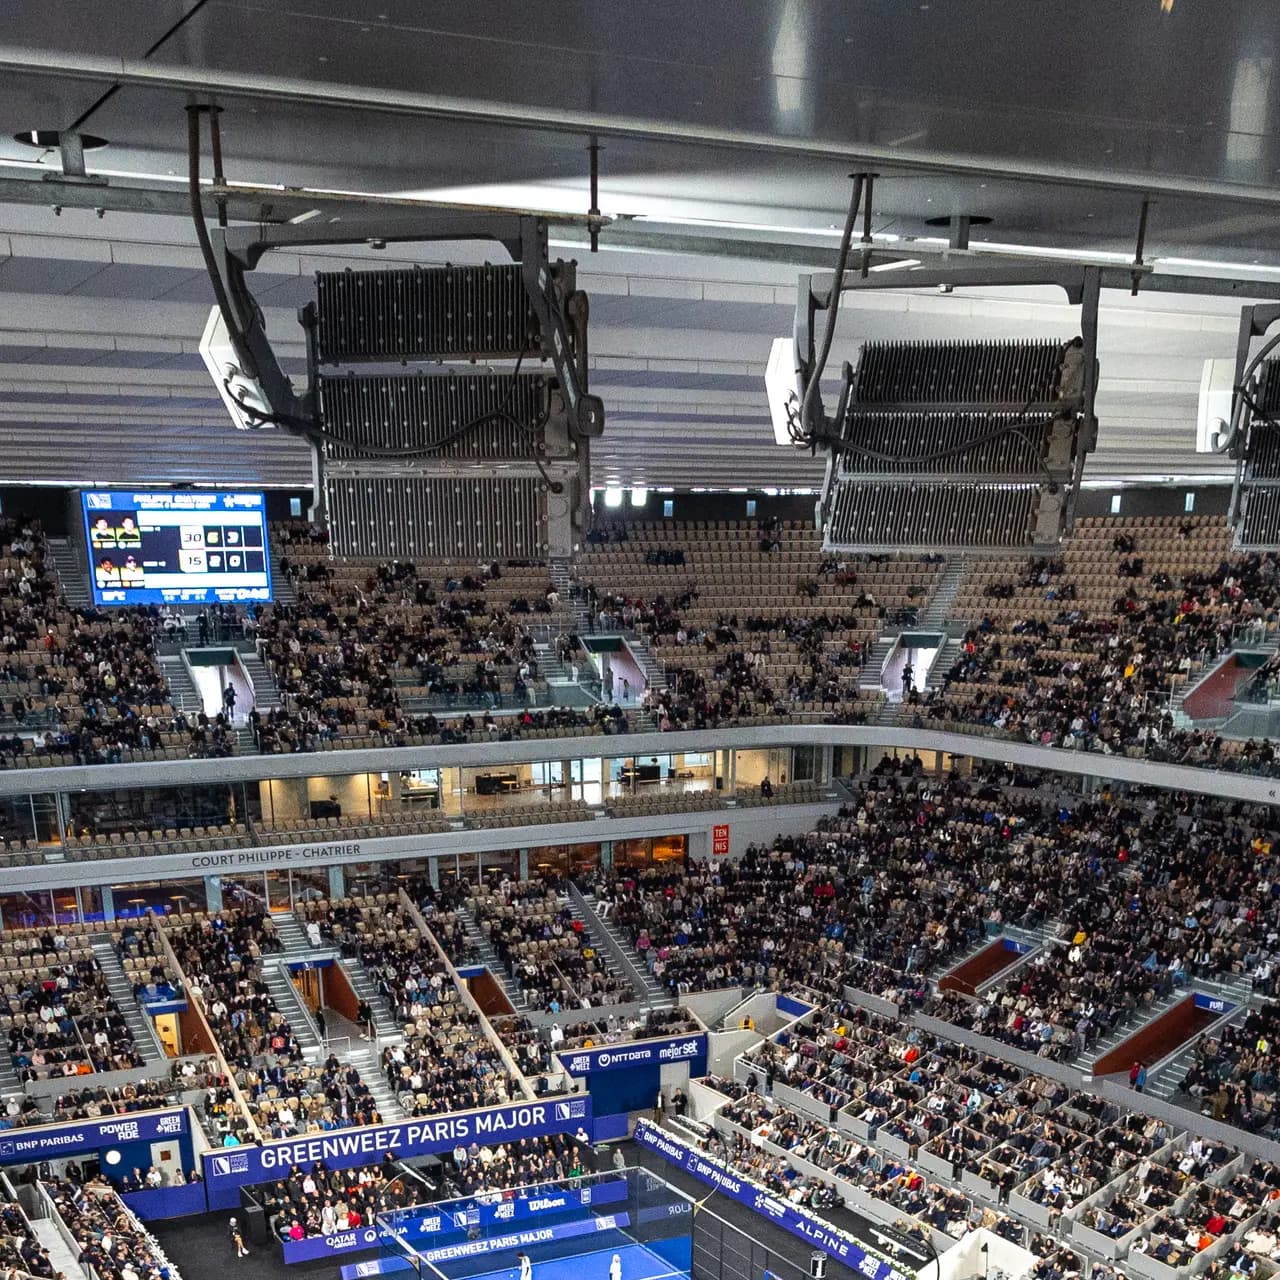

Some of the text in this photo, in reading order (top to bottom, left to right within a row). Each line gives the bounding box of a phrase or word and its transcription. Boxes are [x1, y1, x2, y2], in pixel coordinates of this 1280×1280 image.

[183, 533, 202, 543] 30
[188, 556, 202, 566] 15
[715, 828, 727, 838] TEN
[715, 841, 727, 852] NIS
[192, 854, 234, 868] COURT
[238, 850, 292, 864] PHILIPPE
[302, 844, 361, 858] CHATRIER
[612, 1053, 627, 1063] NTT
[160, 1115, 181, 1126] GREEN
[164, 1122, 181, 1133] WEEZ
[99, 1121, 138, 1135] POWER
[16, 1133, 85, 1151] BNP PARIBAS
[261, 1106, 546, 1168] GREENWEEZ PARIS MAJOR
[644, 1131, 684, 1160] BNP PARIBAS
[696, 1162, 712, 1176] BNP
[528, 1198, 565, 1211] Wilson
[325, 1232, 357, 1247] QATAR
[427, 1229, 554, 1262] GREENWEEZ PARIS MAJOR
[795, 1221, 849, 1256] ALPINE
